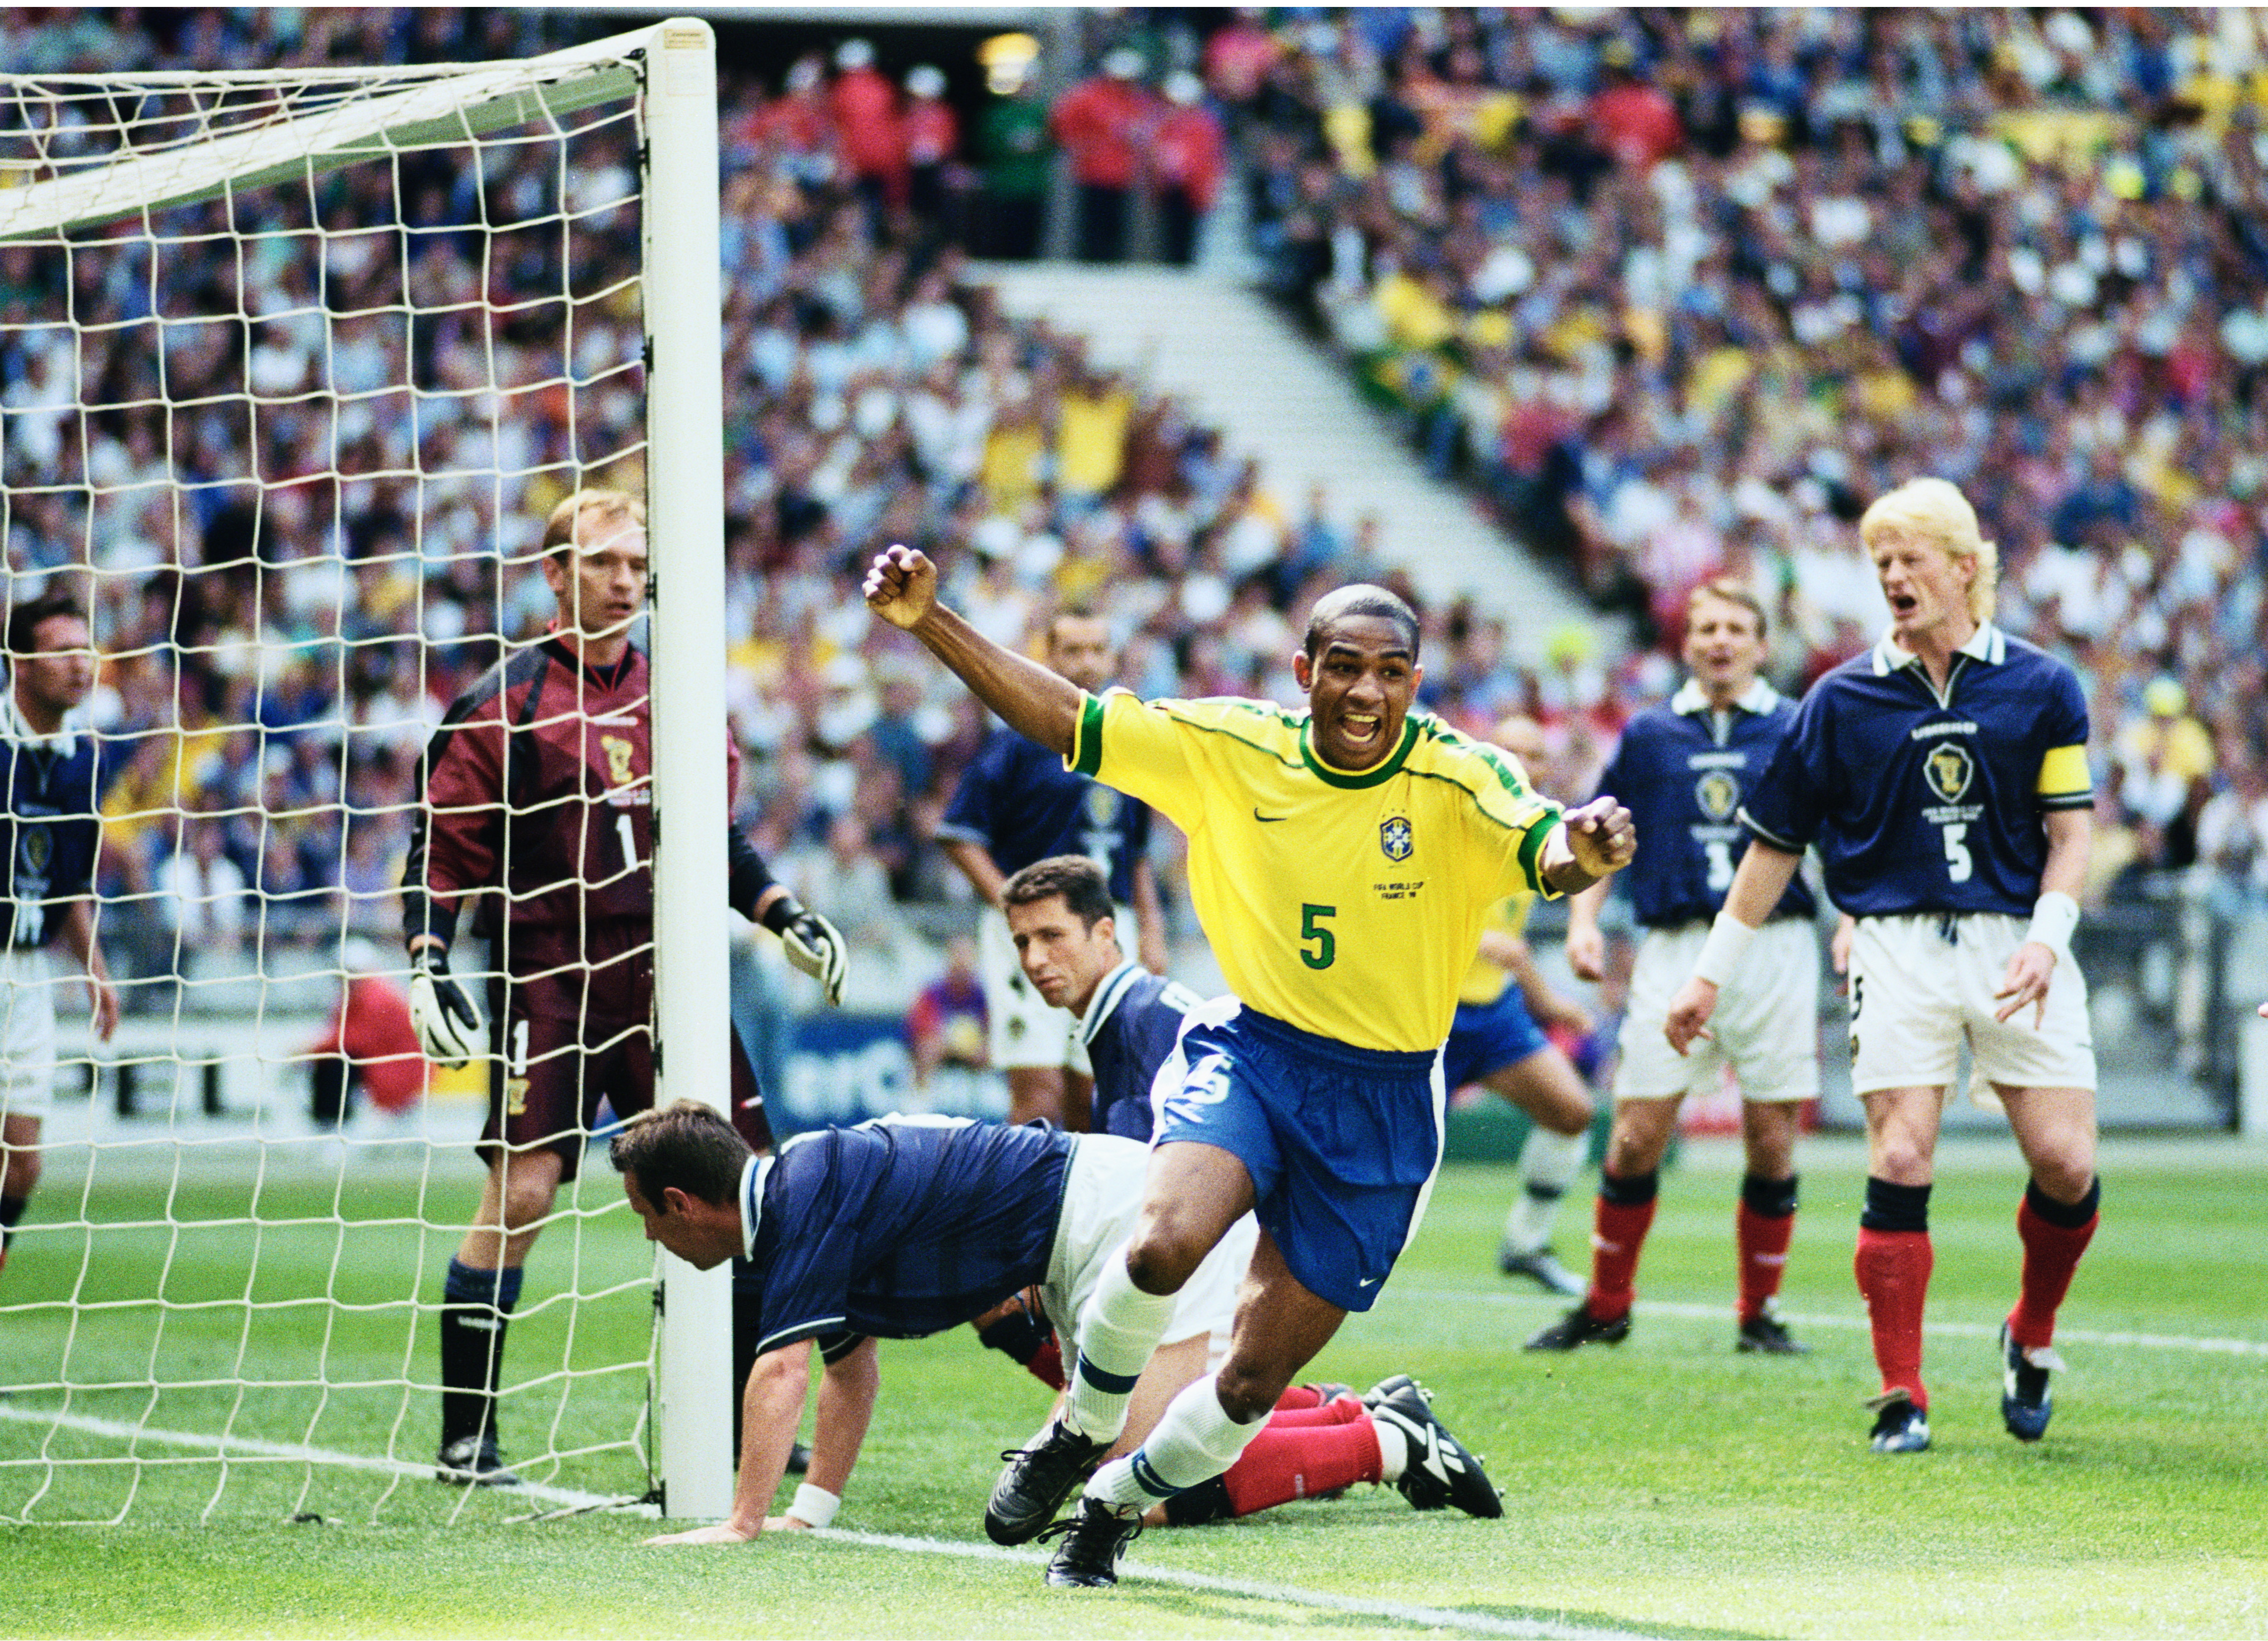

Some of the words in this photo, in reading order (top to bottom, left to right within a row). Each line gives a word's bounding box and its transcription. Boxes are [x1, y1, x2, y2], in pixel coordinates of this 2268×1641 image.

[616, 814, 637, 872] 1
[1943, 823, 1971, 882] 5
[1300, 903, 1336, 970] 5
[513, 1020, 529, 1076] 1
